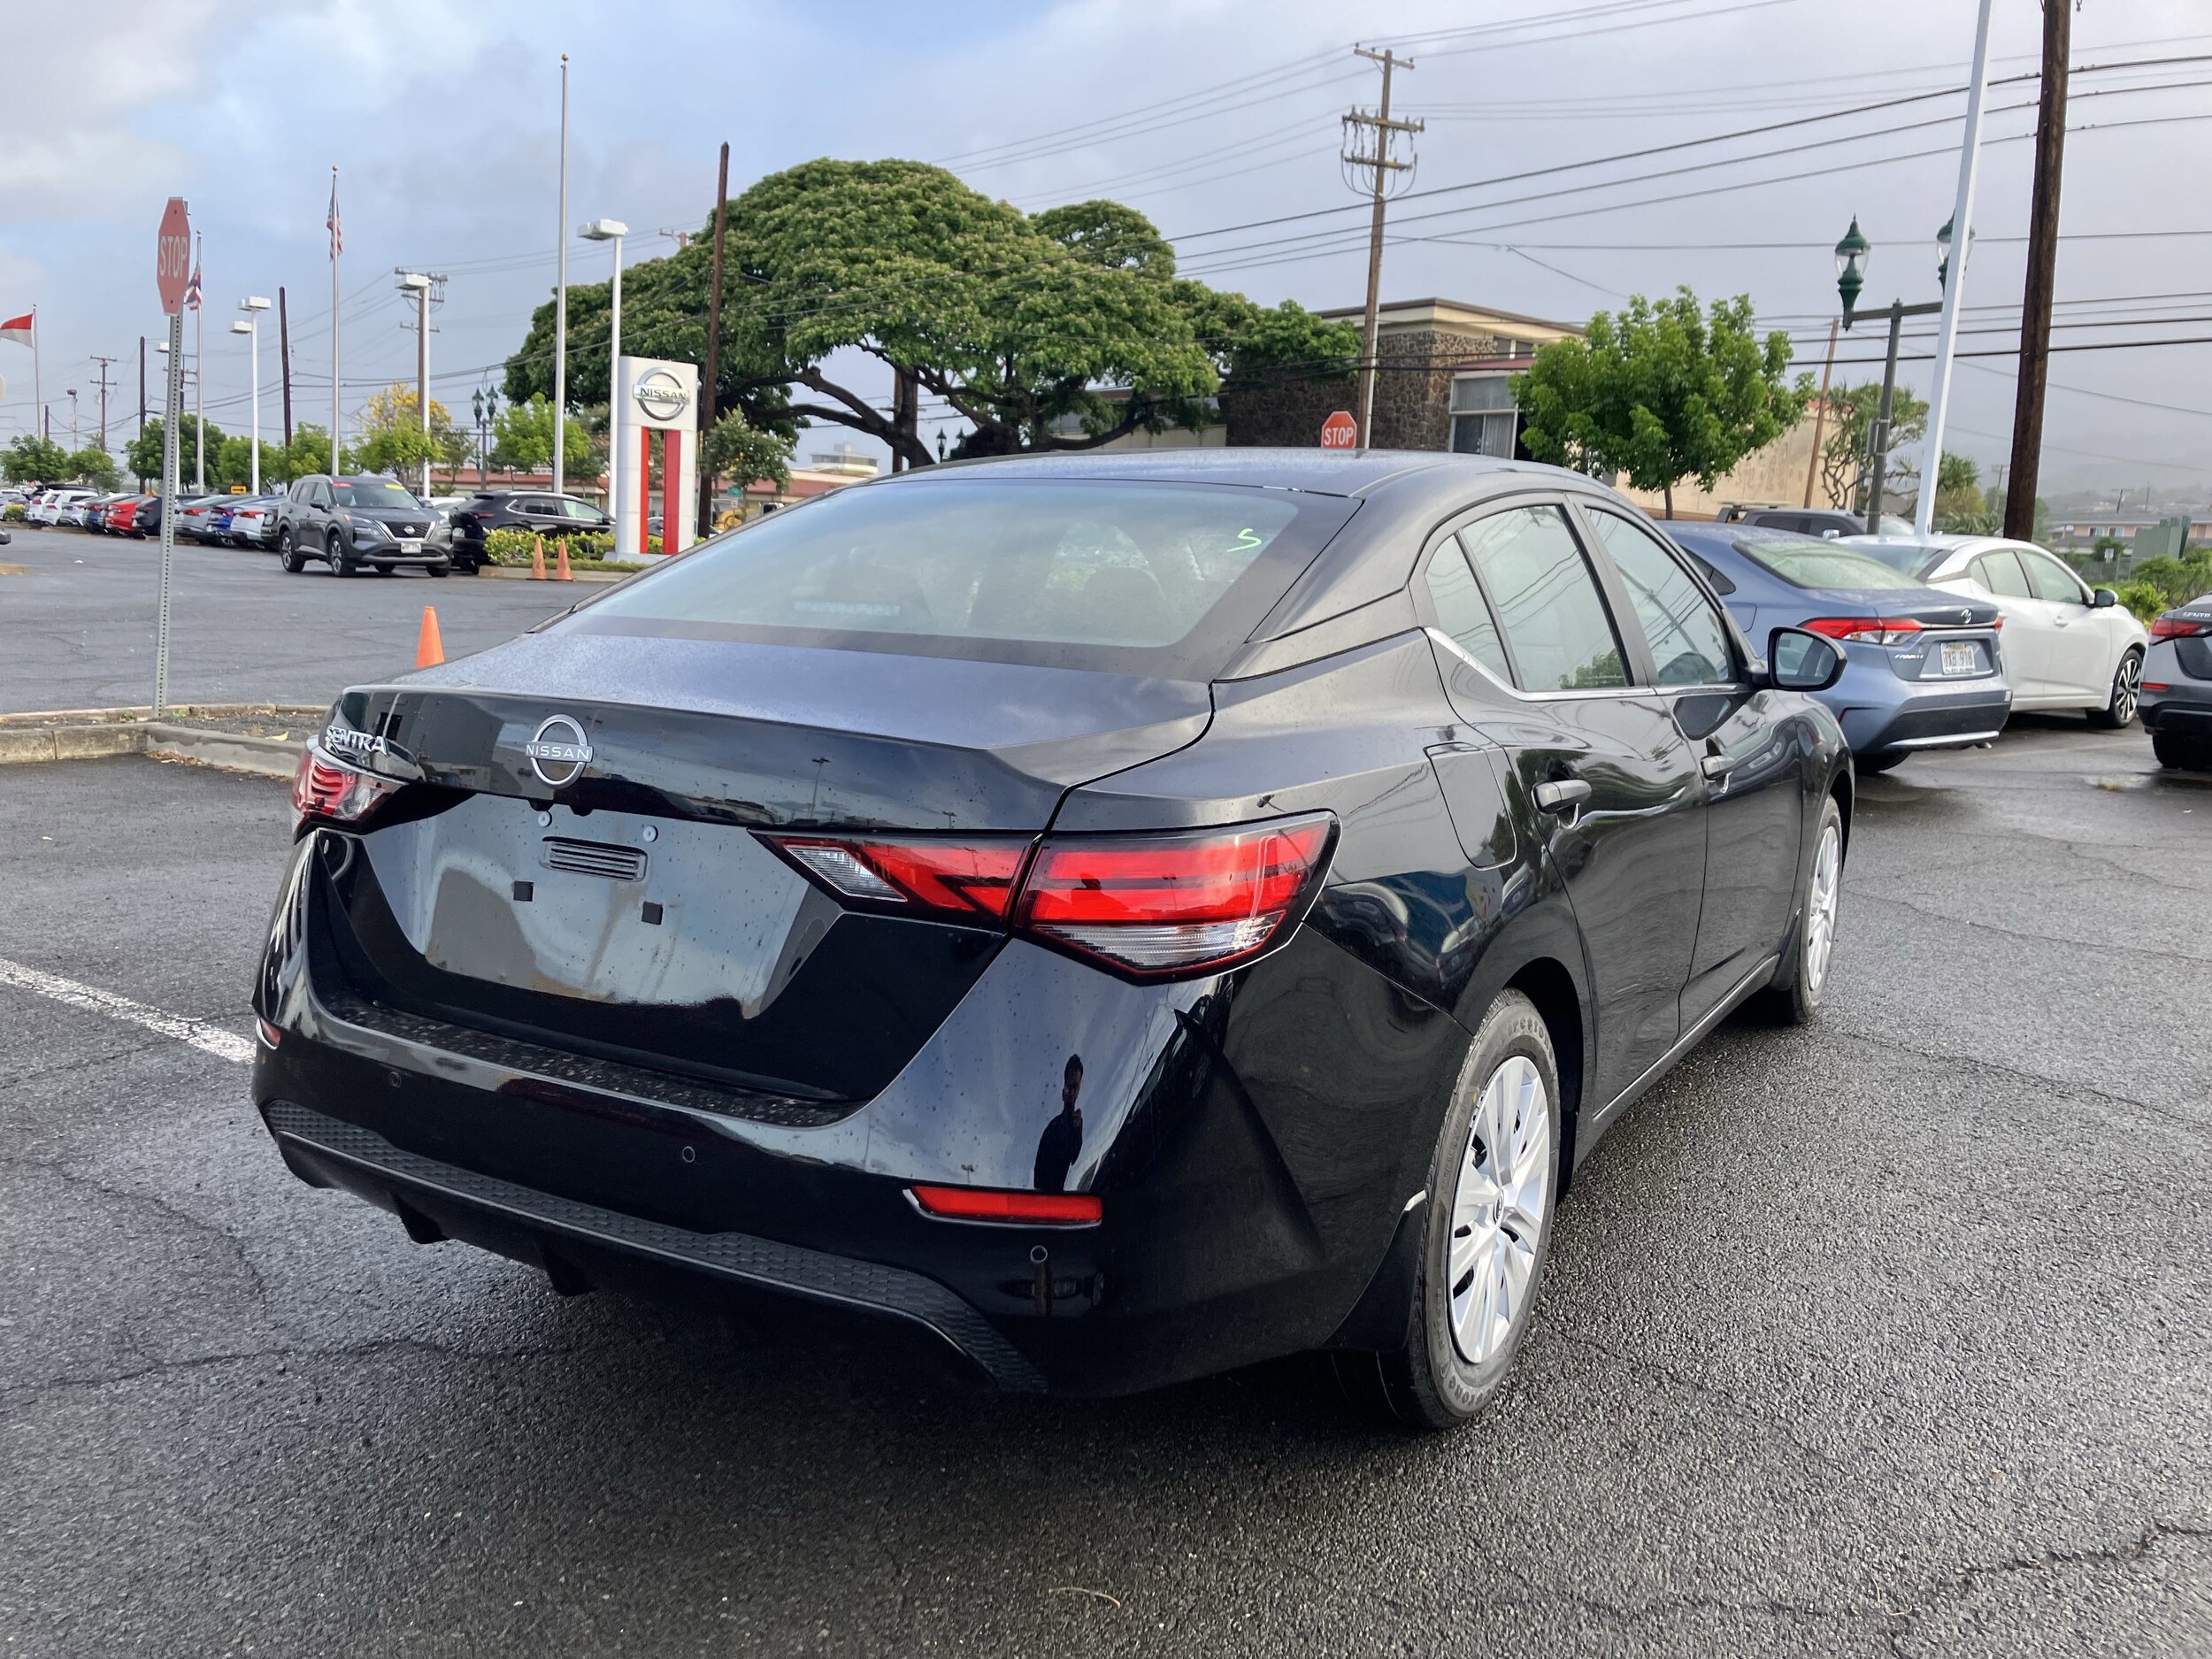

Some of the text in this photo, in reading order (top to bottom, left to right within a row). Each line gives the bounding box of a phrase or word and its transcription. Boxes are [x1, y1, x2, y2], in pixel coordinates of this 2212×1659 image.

[159, 235, 188, 279] STOP
[640, 387, 687, 400] NISSAN
[1324, 426, 1354, 445] STOP
[326, 725, 389, 757] SENTRA
[526, 743, 591, 761] NISSAN
